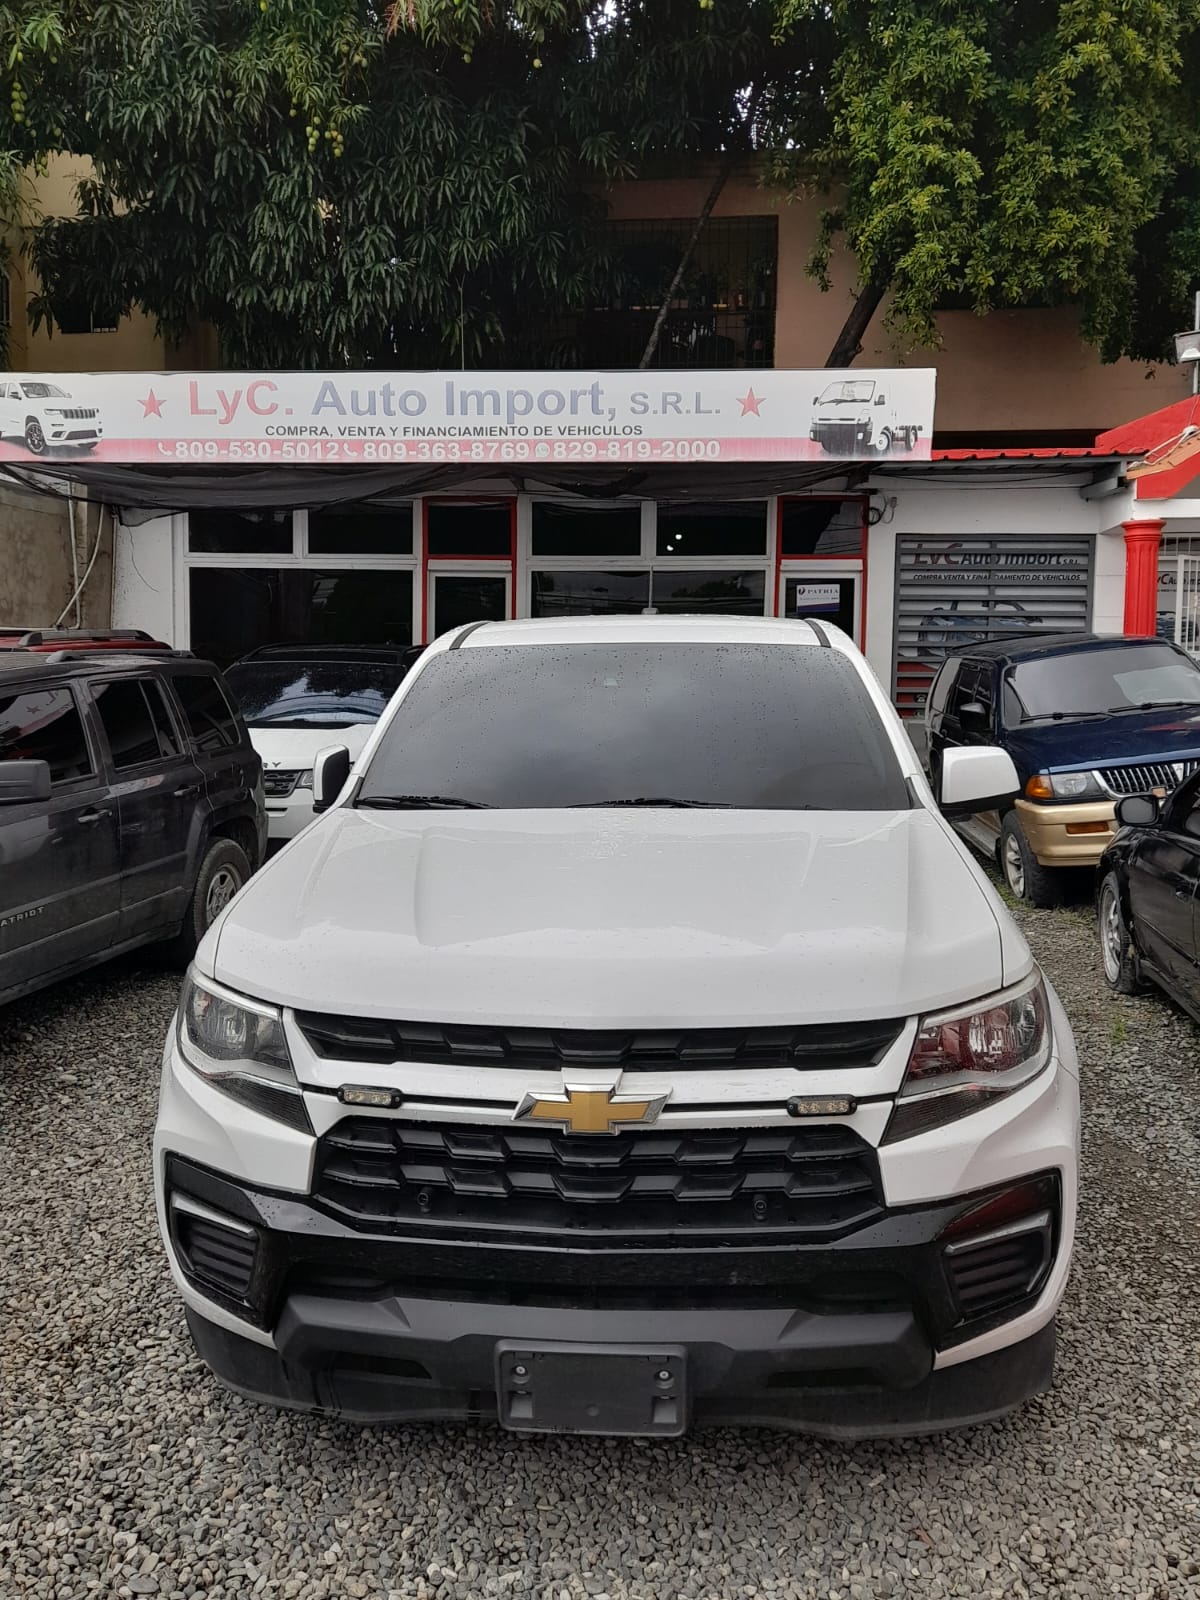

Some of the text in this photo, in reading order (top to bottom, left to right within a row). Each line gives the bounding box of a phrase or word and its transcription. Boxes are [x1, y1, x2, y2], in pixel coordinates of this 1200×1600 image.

[189, 380, 721, 425] LyC. Auto Import, S.R.L.
[265, 425, 643, 437] COMPRA, VENTA Y FINANCIAMIENTO DE VEHICULOS
[175, 440, 721, 460] 809-530-5012 809-363-8769 829-819-2000
[0, 906, 45, 927] ATRIOT
